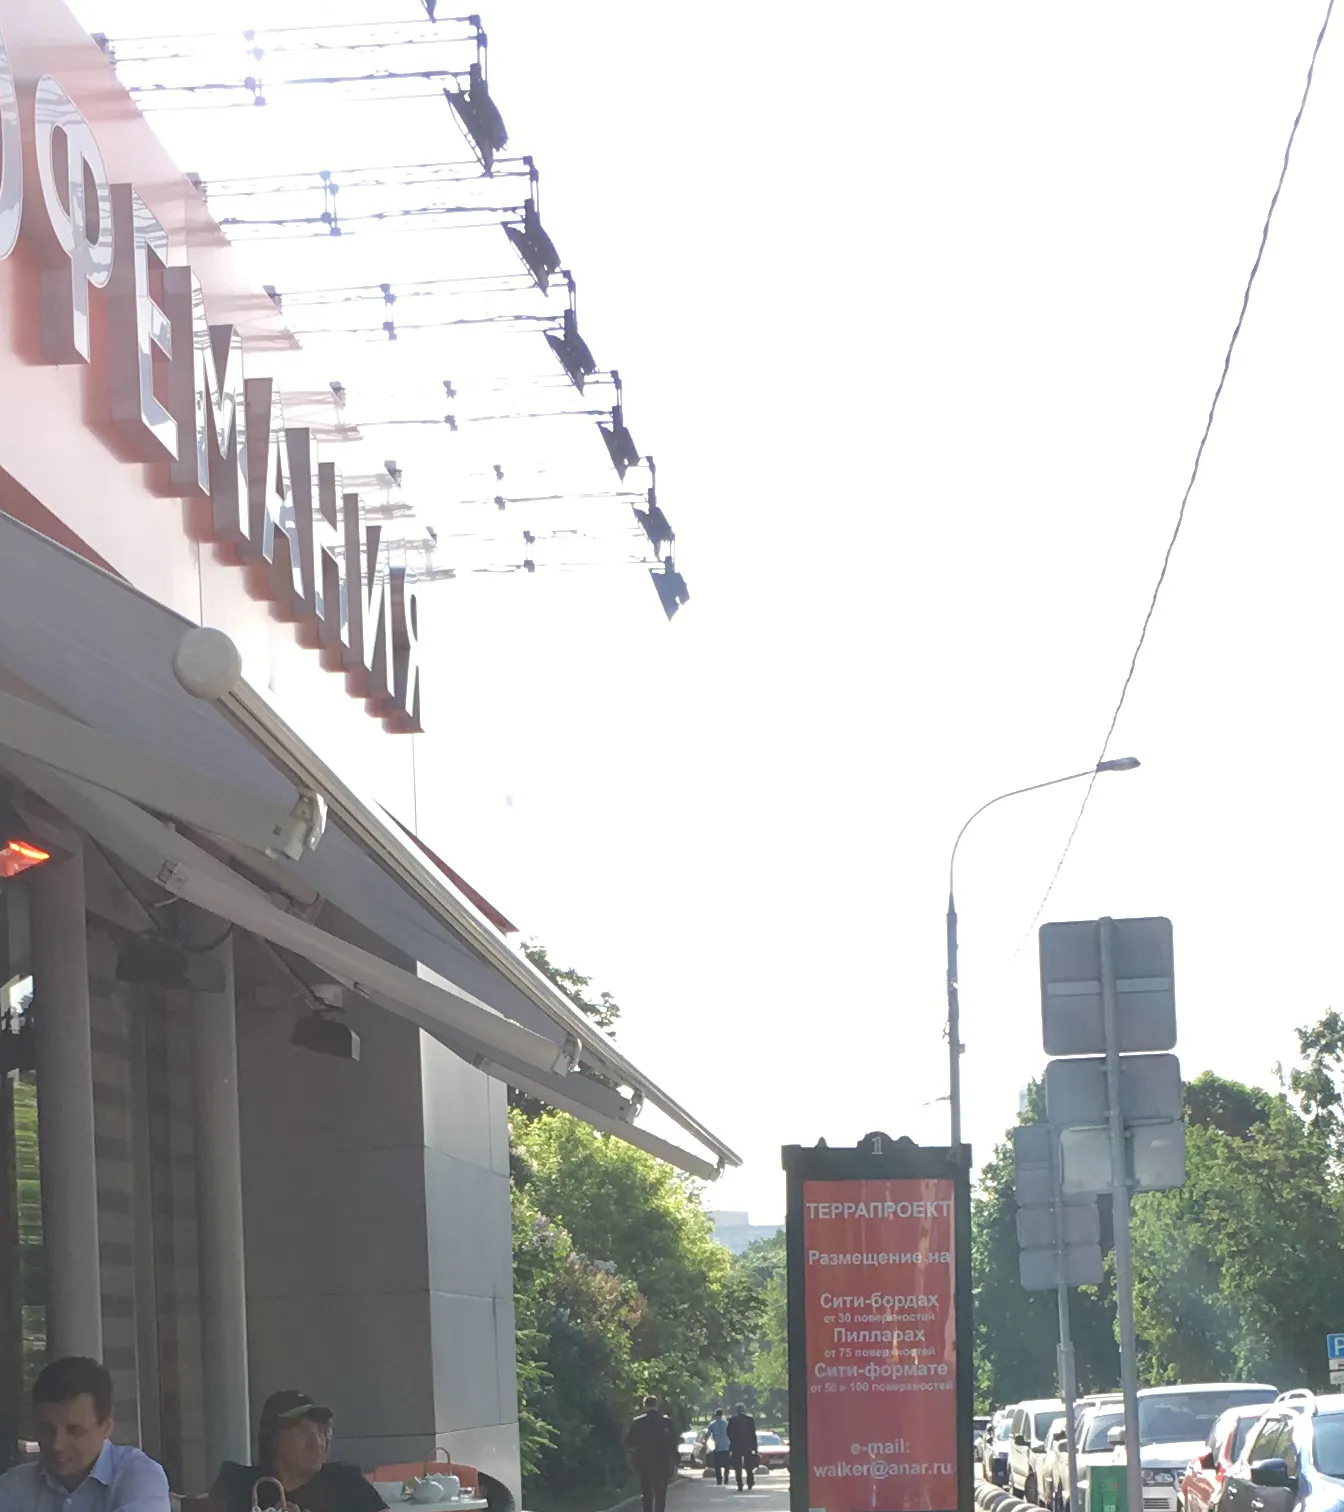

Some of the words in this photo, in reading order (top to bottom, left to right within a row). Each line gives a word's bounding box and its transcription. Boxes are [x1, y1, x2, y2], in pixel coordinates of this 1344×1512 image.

[871, 1136, 884, 1155] 1
[806, 1201, 951, 1219] ТЕРРАПРОЕКТ
[808, 1250, 922, 1266] Размещение
[928, 1251, 950, 1264] на
[820, 1292, 939, 1310] Сити-бордах
[838, 1313, 851, 1323] 30
[833, 1327, 925, 1344] Пилларах
[824, 1350, 836, 1358] от
[839, 1348, 852, 1358] 75
[814, 1362, 948, 1380] Сити-формате
[850, 1438, 910, 1455] e-mail:
[813, 1460, 952, 1480] walker@anar.ru
